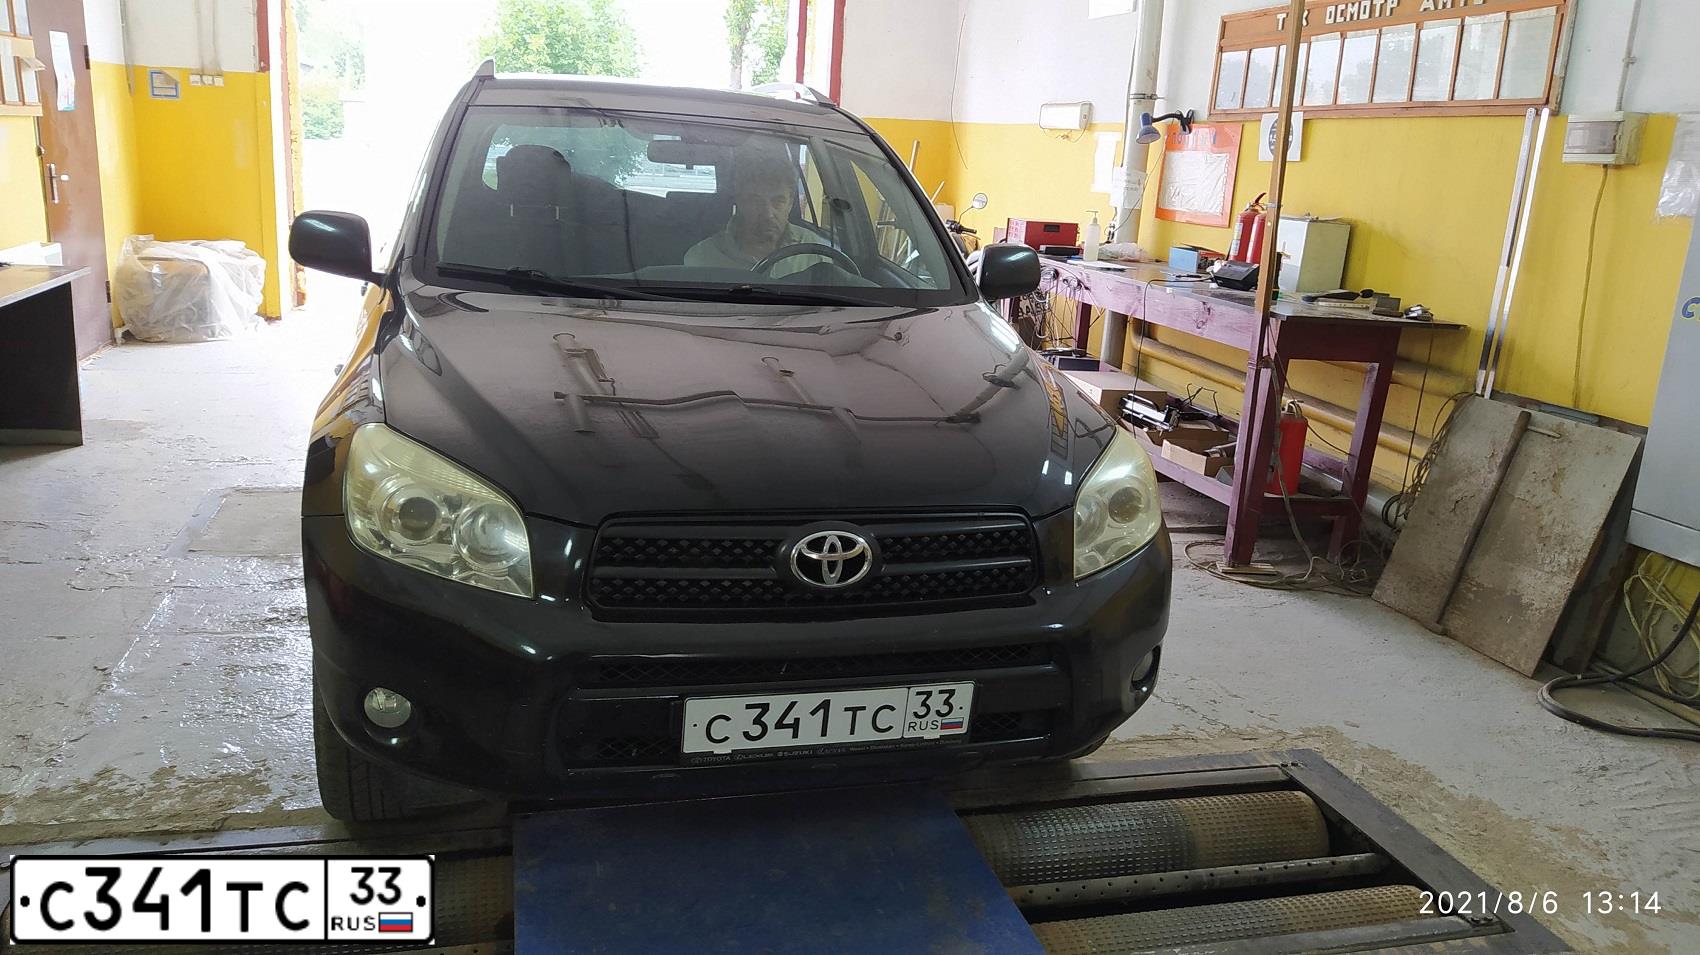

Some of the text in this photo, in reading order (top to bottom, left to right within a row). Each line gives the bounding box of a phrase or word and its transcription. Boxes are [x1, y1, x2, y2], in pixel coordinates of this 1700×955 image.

[1325, 0, 1398, 25] ОСМОТР
[912, 688, 956, 719] 33
[907, 719, 940, 732] RUS
